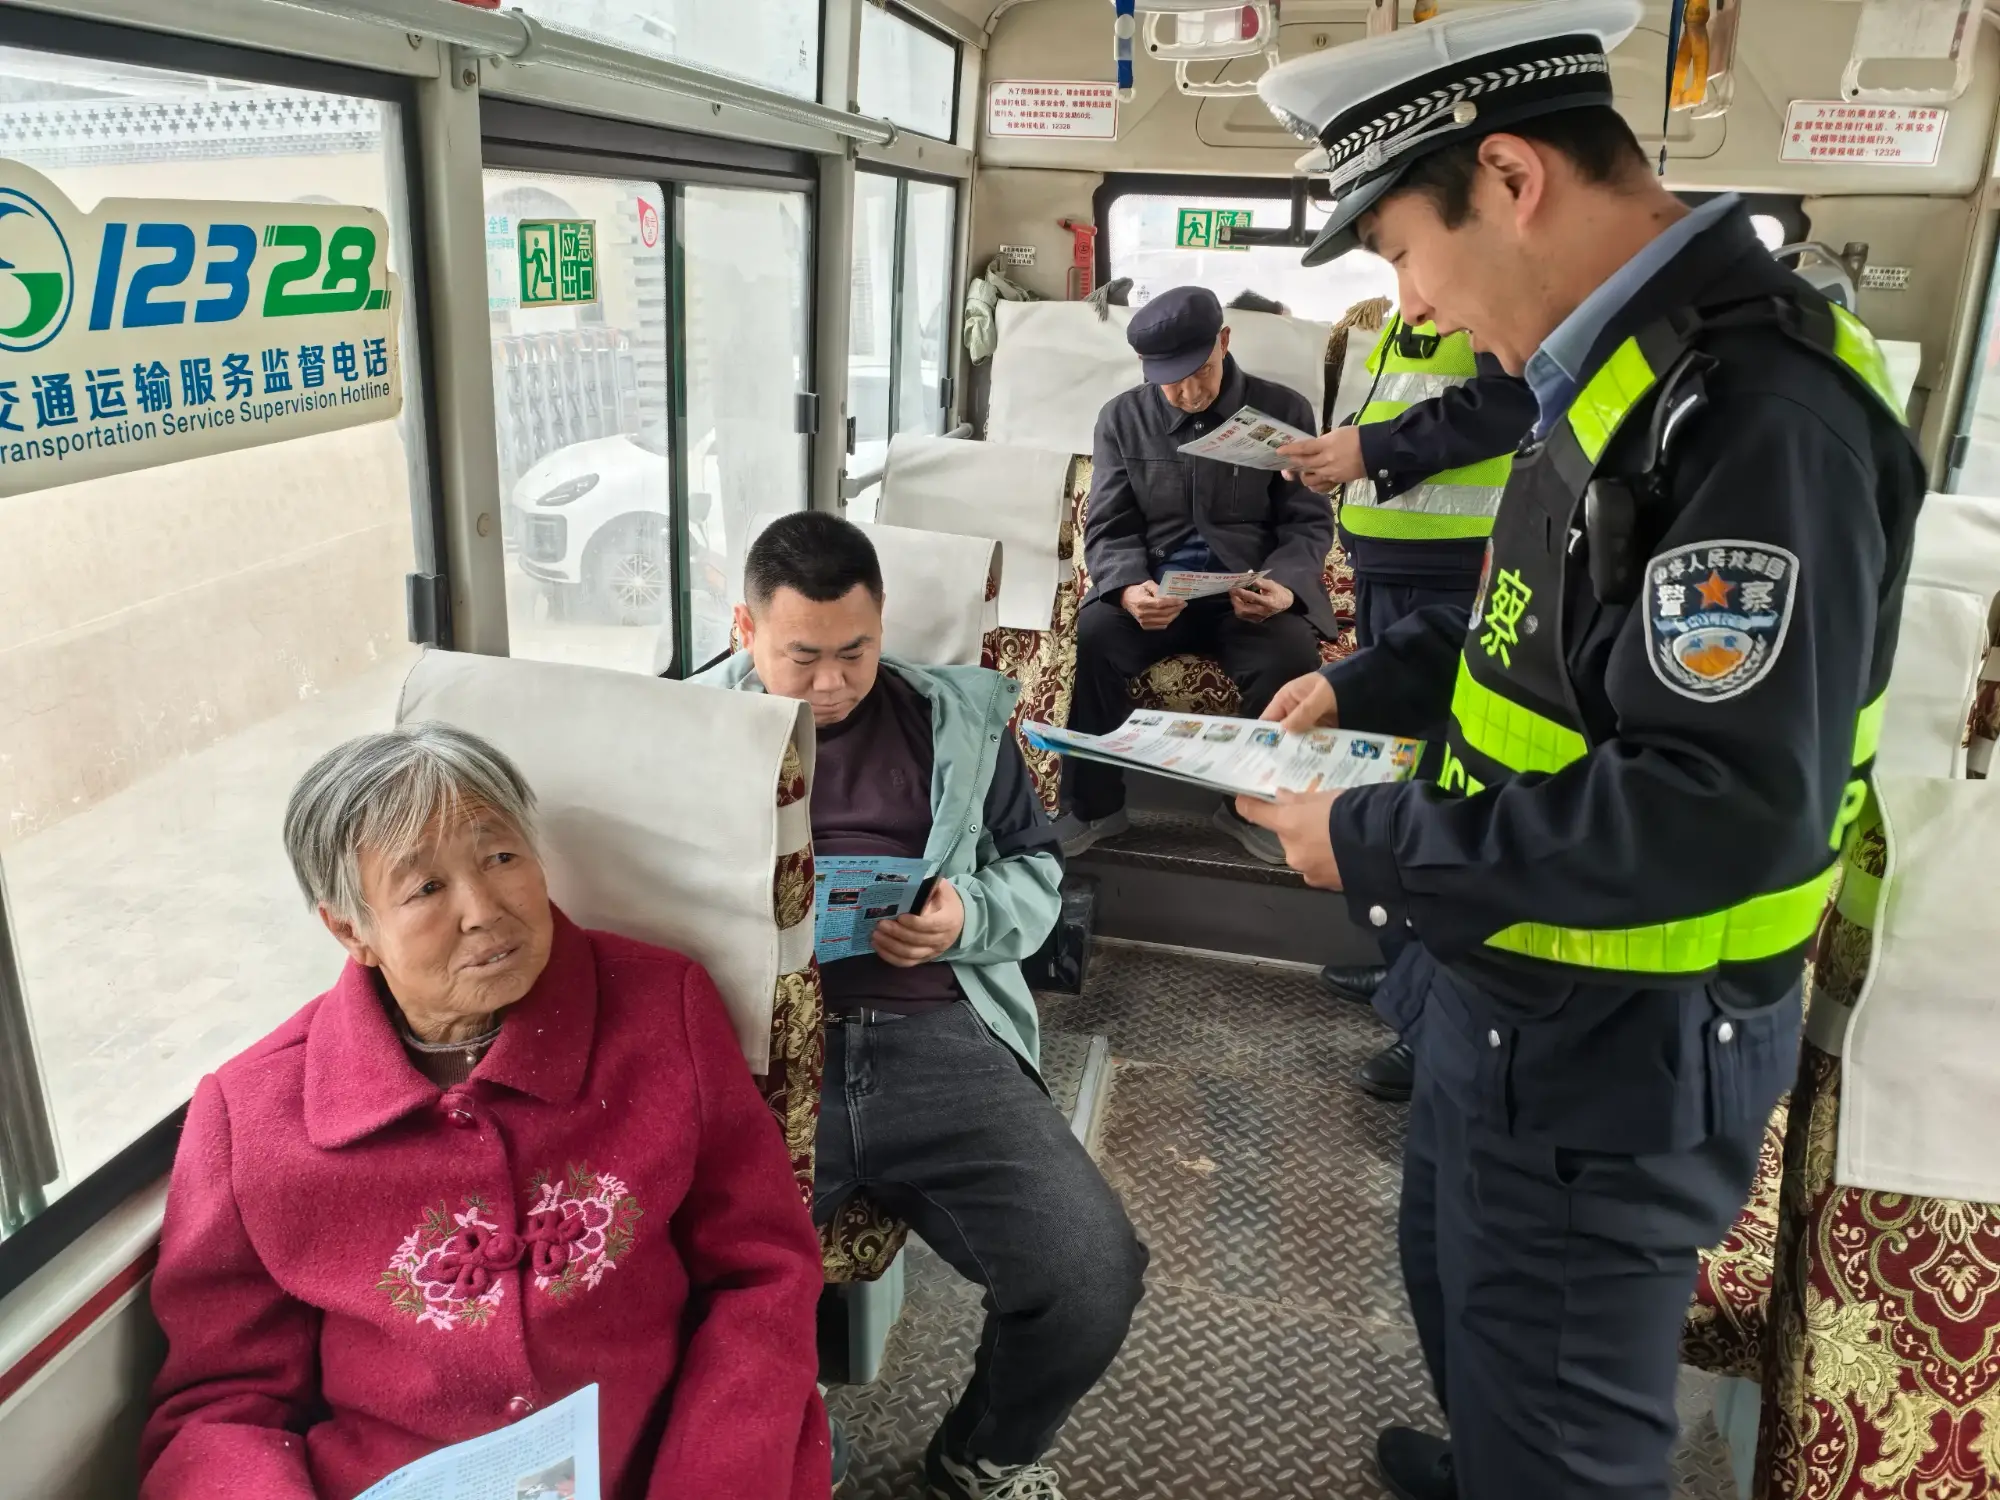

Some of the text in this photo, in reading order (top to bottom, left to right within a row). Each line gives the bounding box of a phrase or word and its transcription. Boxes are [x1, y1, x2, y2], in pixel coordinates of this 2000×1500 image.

[561, 224, 593, 262] 应急
[88, 223, 391, 331] 12328
[562, 262, 593, 300] 出口
[162, 407, 235, 436] Service
[240, 391, 337, 423] Supervision
[341, 381, 390, 404] Hotline
